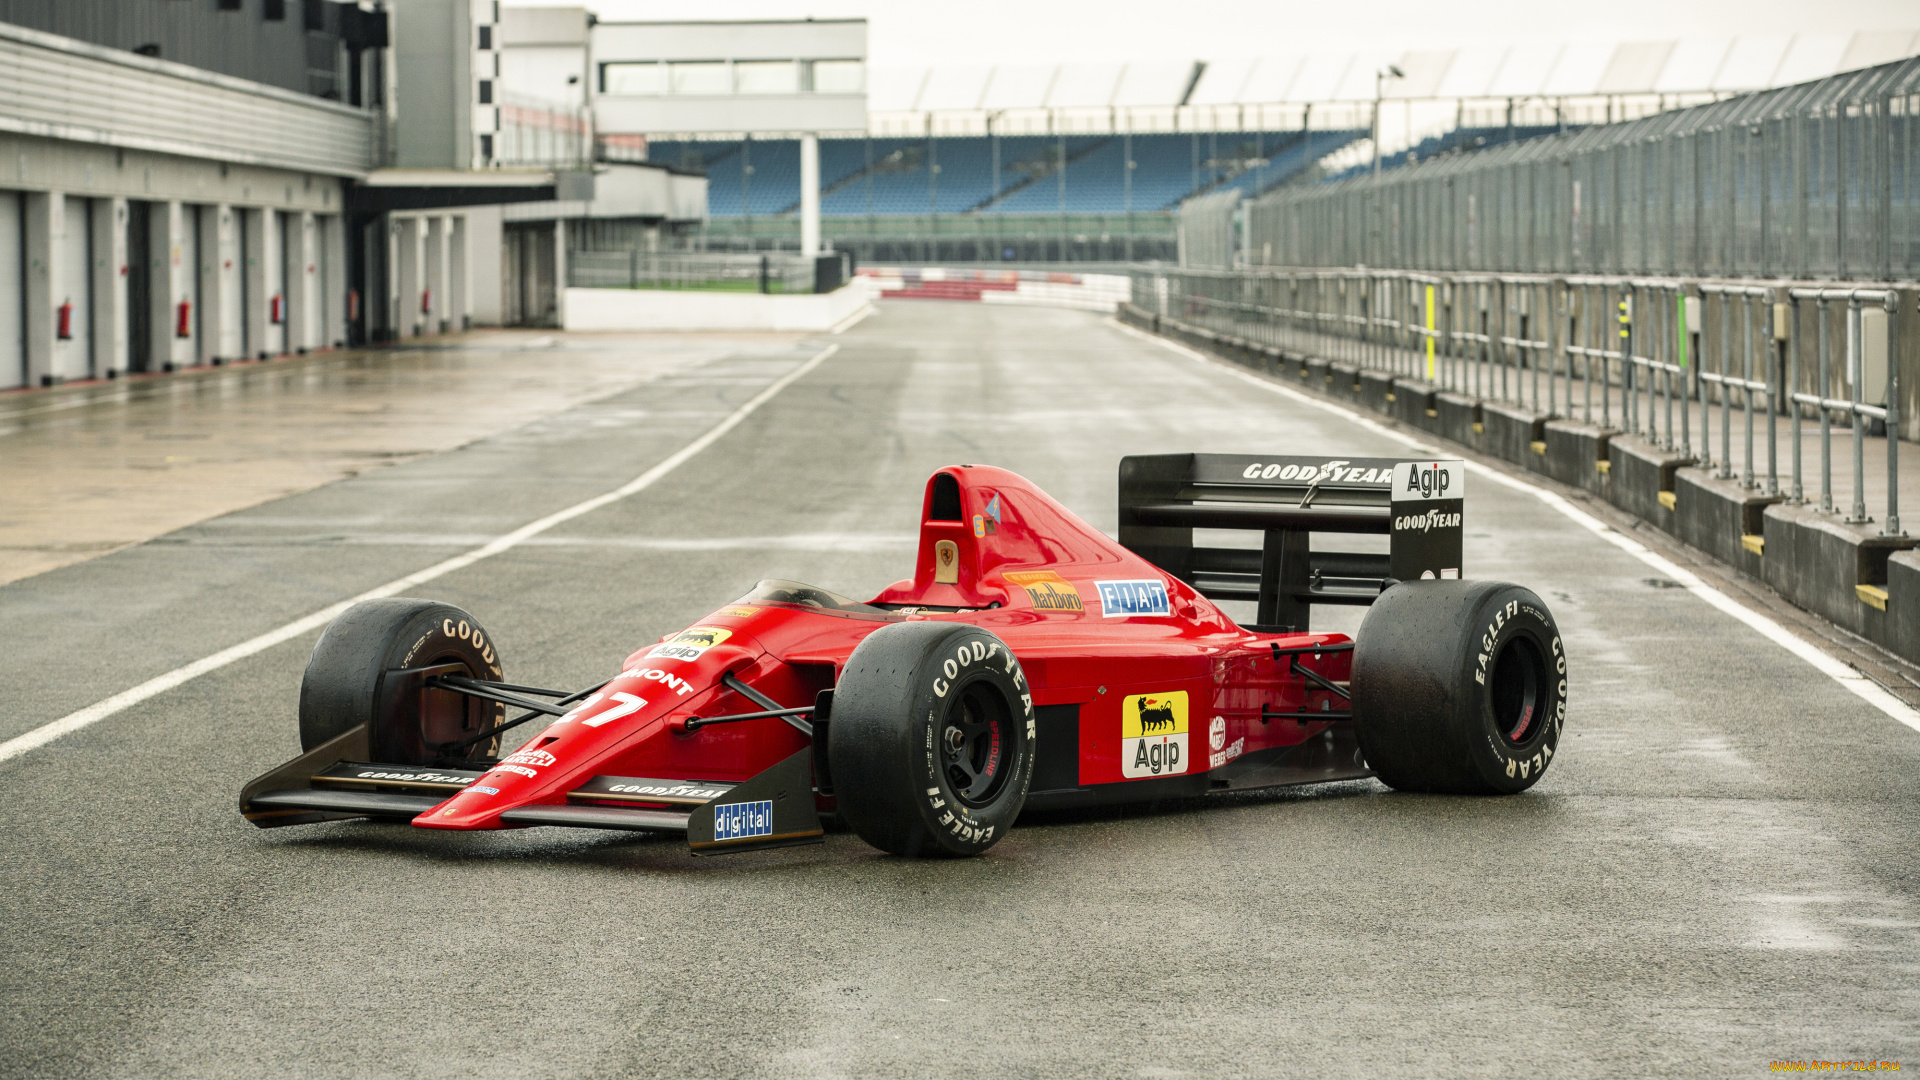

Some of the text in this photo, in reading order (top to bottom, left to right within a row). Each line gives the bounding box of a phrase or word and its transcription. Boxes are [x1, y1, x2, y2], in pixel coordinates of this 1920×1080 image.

[1407, 463, 1450, 498] Agip
[1026, 583, 1082, 610] Marlboro
[1104, 586, 1164, 609] FIAT
[651, 646, 700, 658] Agip
[1475, 609, 1505, 686] EAGLE
[985, 721, 1000, 776] SPEEDLINE
[1134, 736, 1180, 774] Agip
[716, 809, 769, 833] digital
[938, 810, 995, 844] EAGLE
